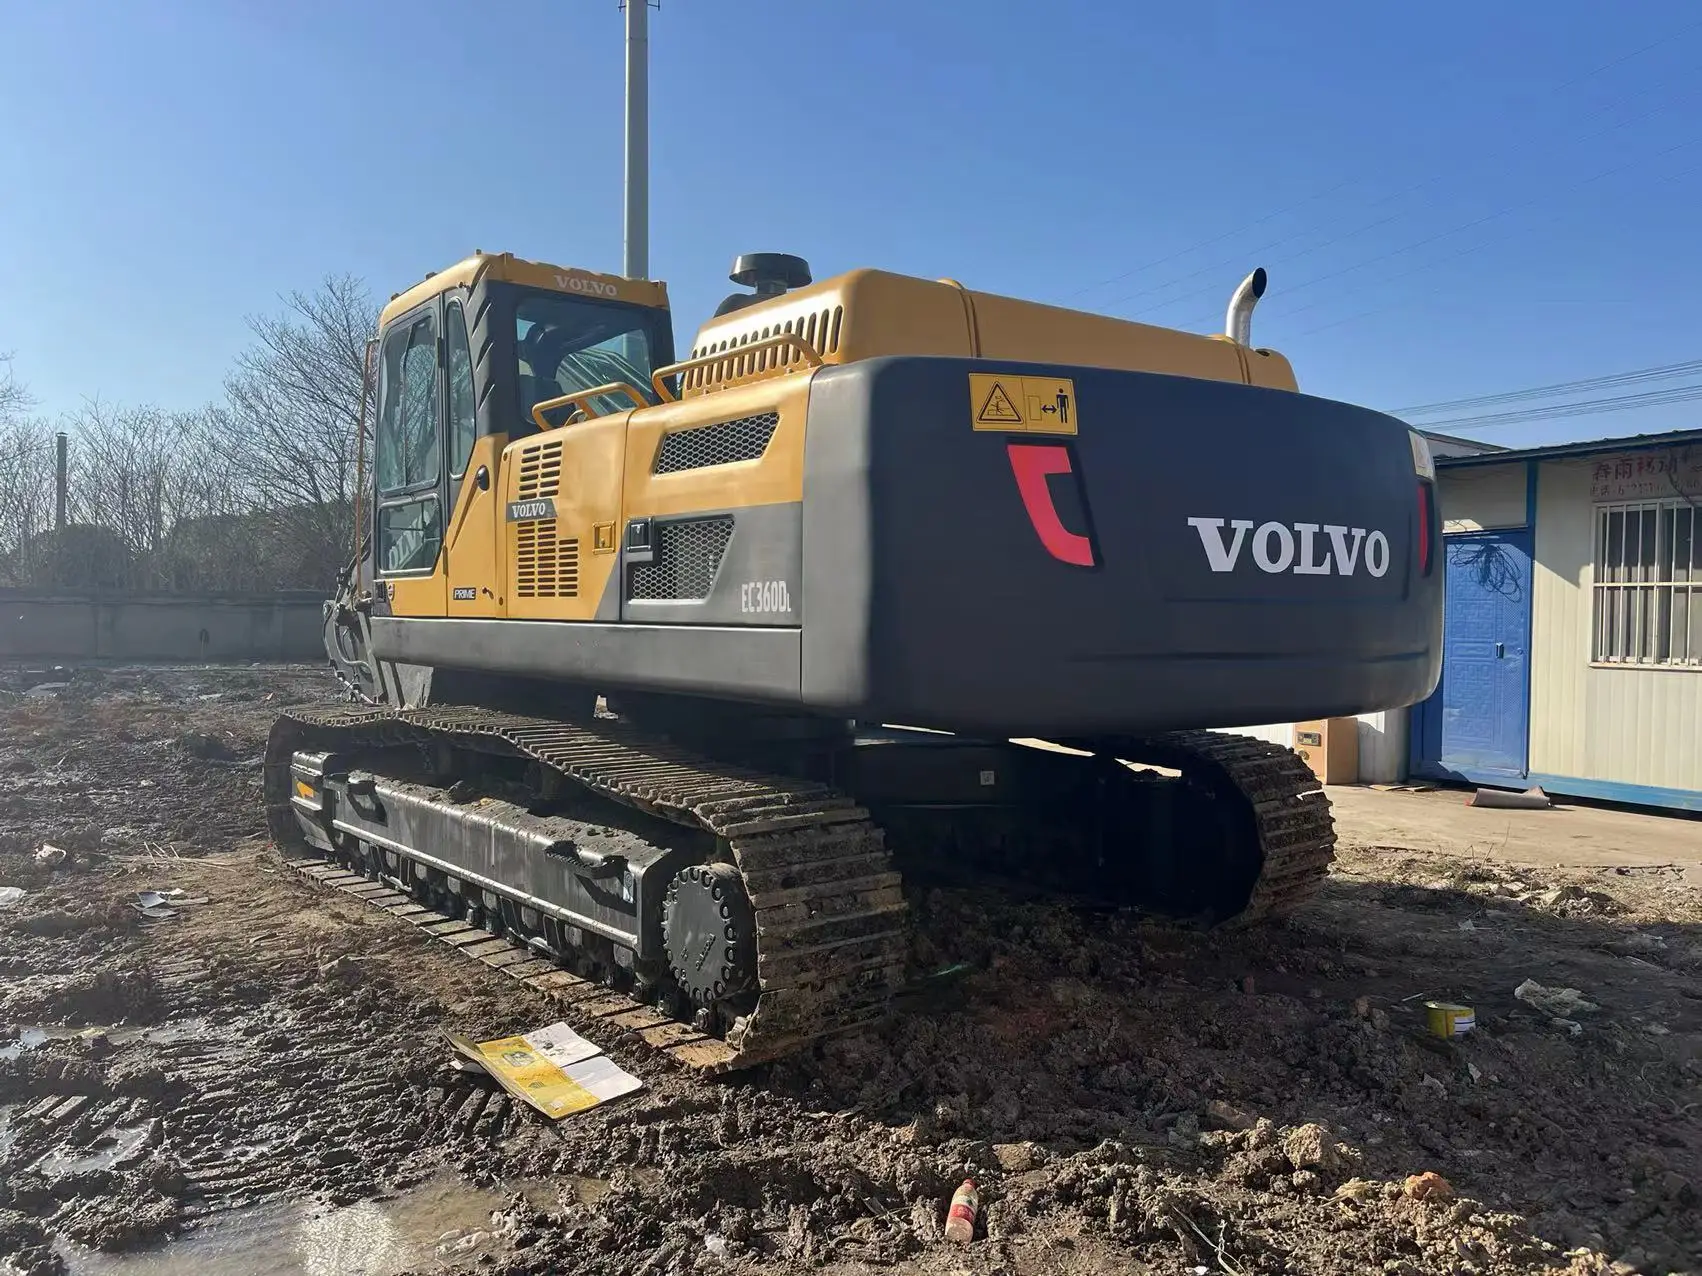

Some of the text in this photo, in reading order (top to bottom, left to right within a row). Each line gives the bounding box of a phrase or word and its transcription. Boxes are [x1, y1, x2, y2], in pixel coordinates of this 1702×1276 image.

[553, 274, 618, 297] VOLVO
[510, 502, 546, 518] VOLVO
[1187, 516, 1390, 578] VOLVO
[453, 588, 476, 600] PRIME
